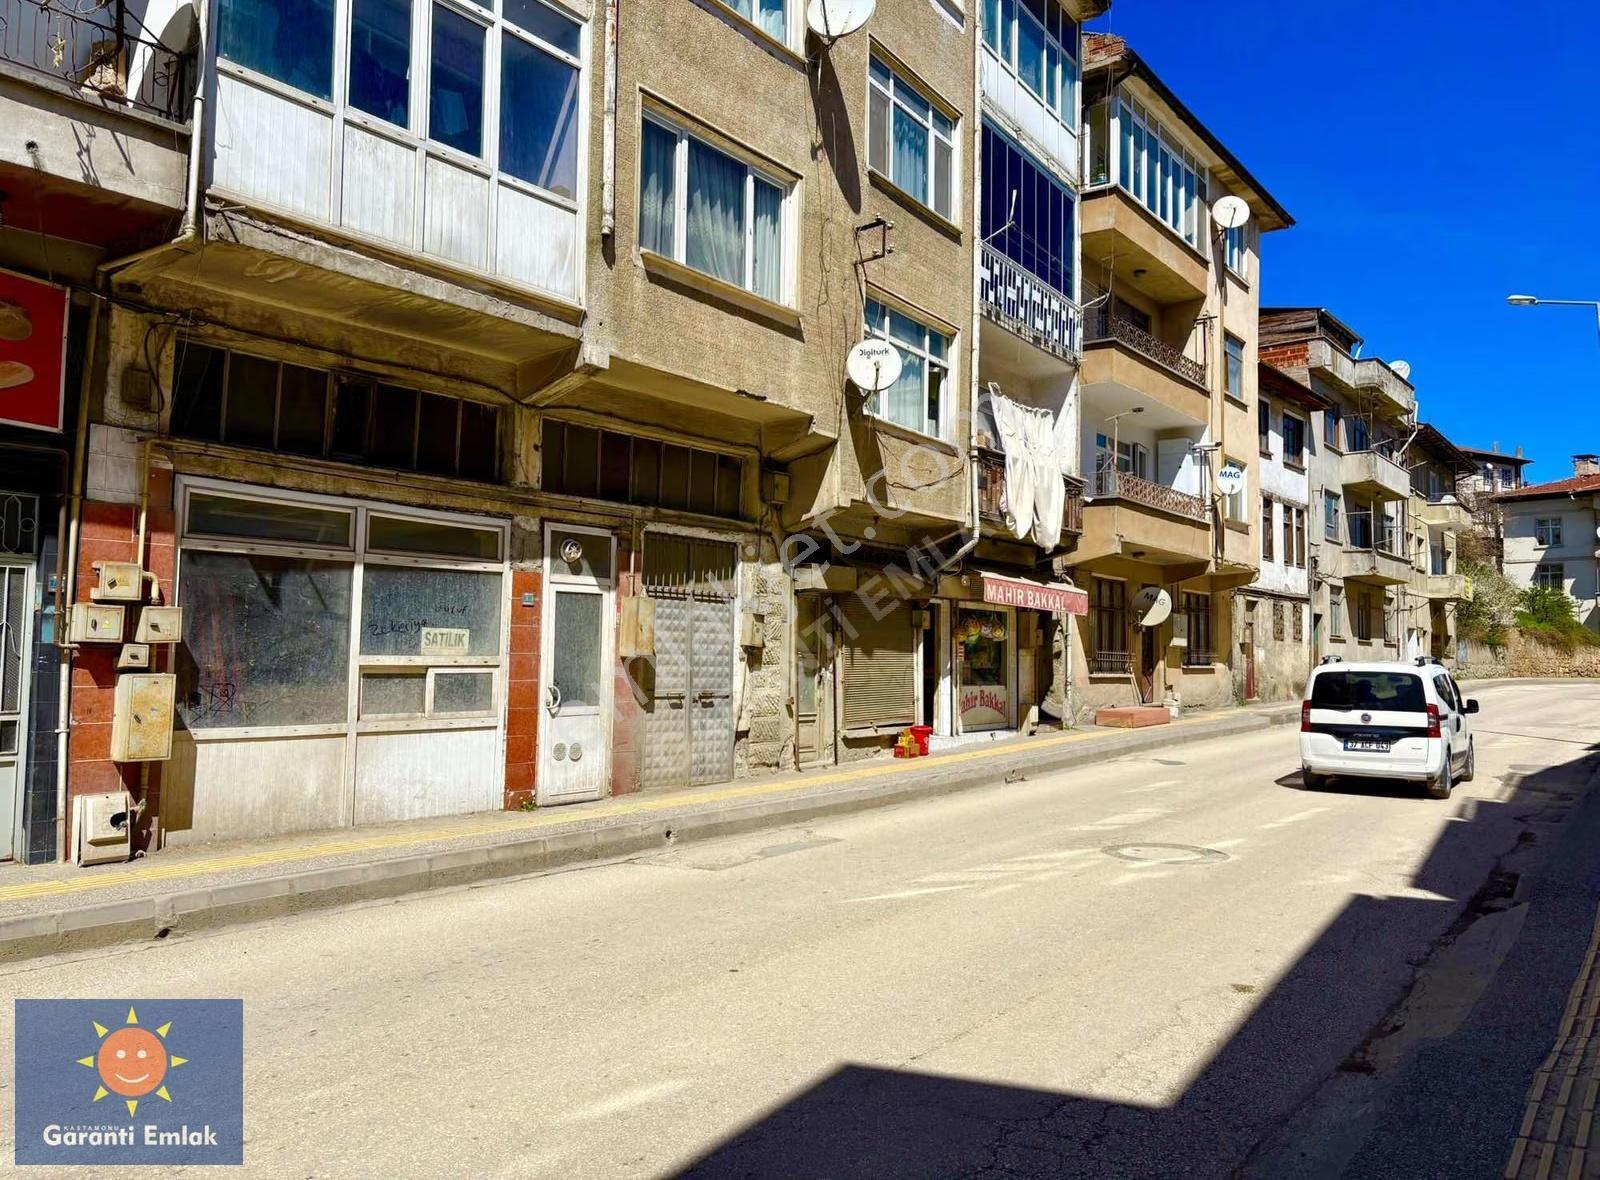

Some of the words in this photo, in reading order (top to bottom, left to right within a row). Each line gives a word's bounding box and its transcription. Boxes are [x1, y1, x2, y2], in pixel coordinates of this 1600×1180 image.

[1219, 470, 1241, 479] MAG
[1027, 590, 1066, 611] BAKKAL
[960, 691, 978, 714] ahir
[979, 689, 1006, 718] Bakkal
